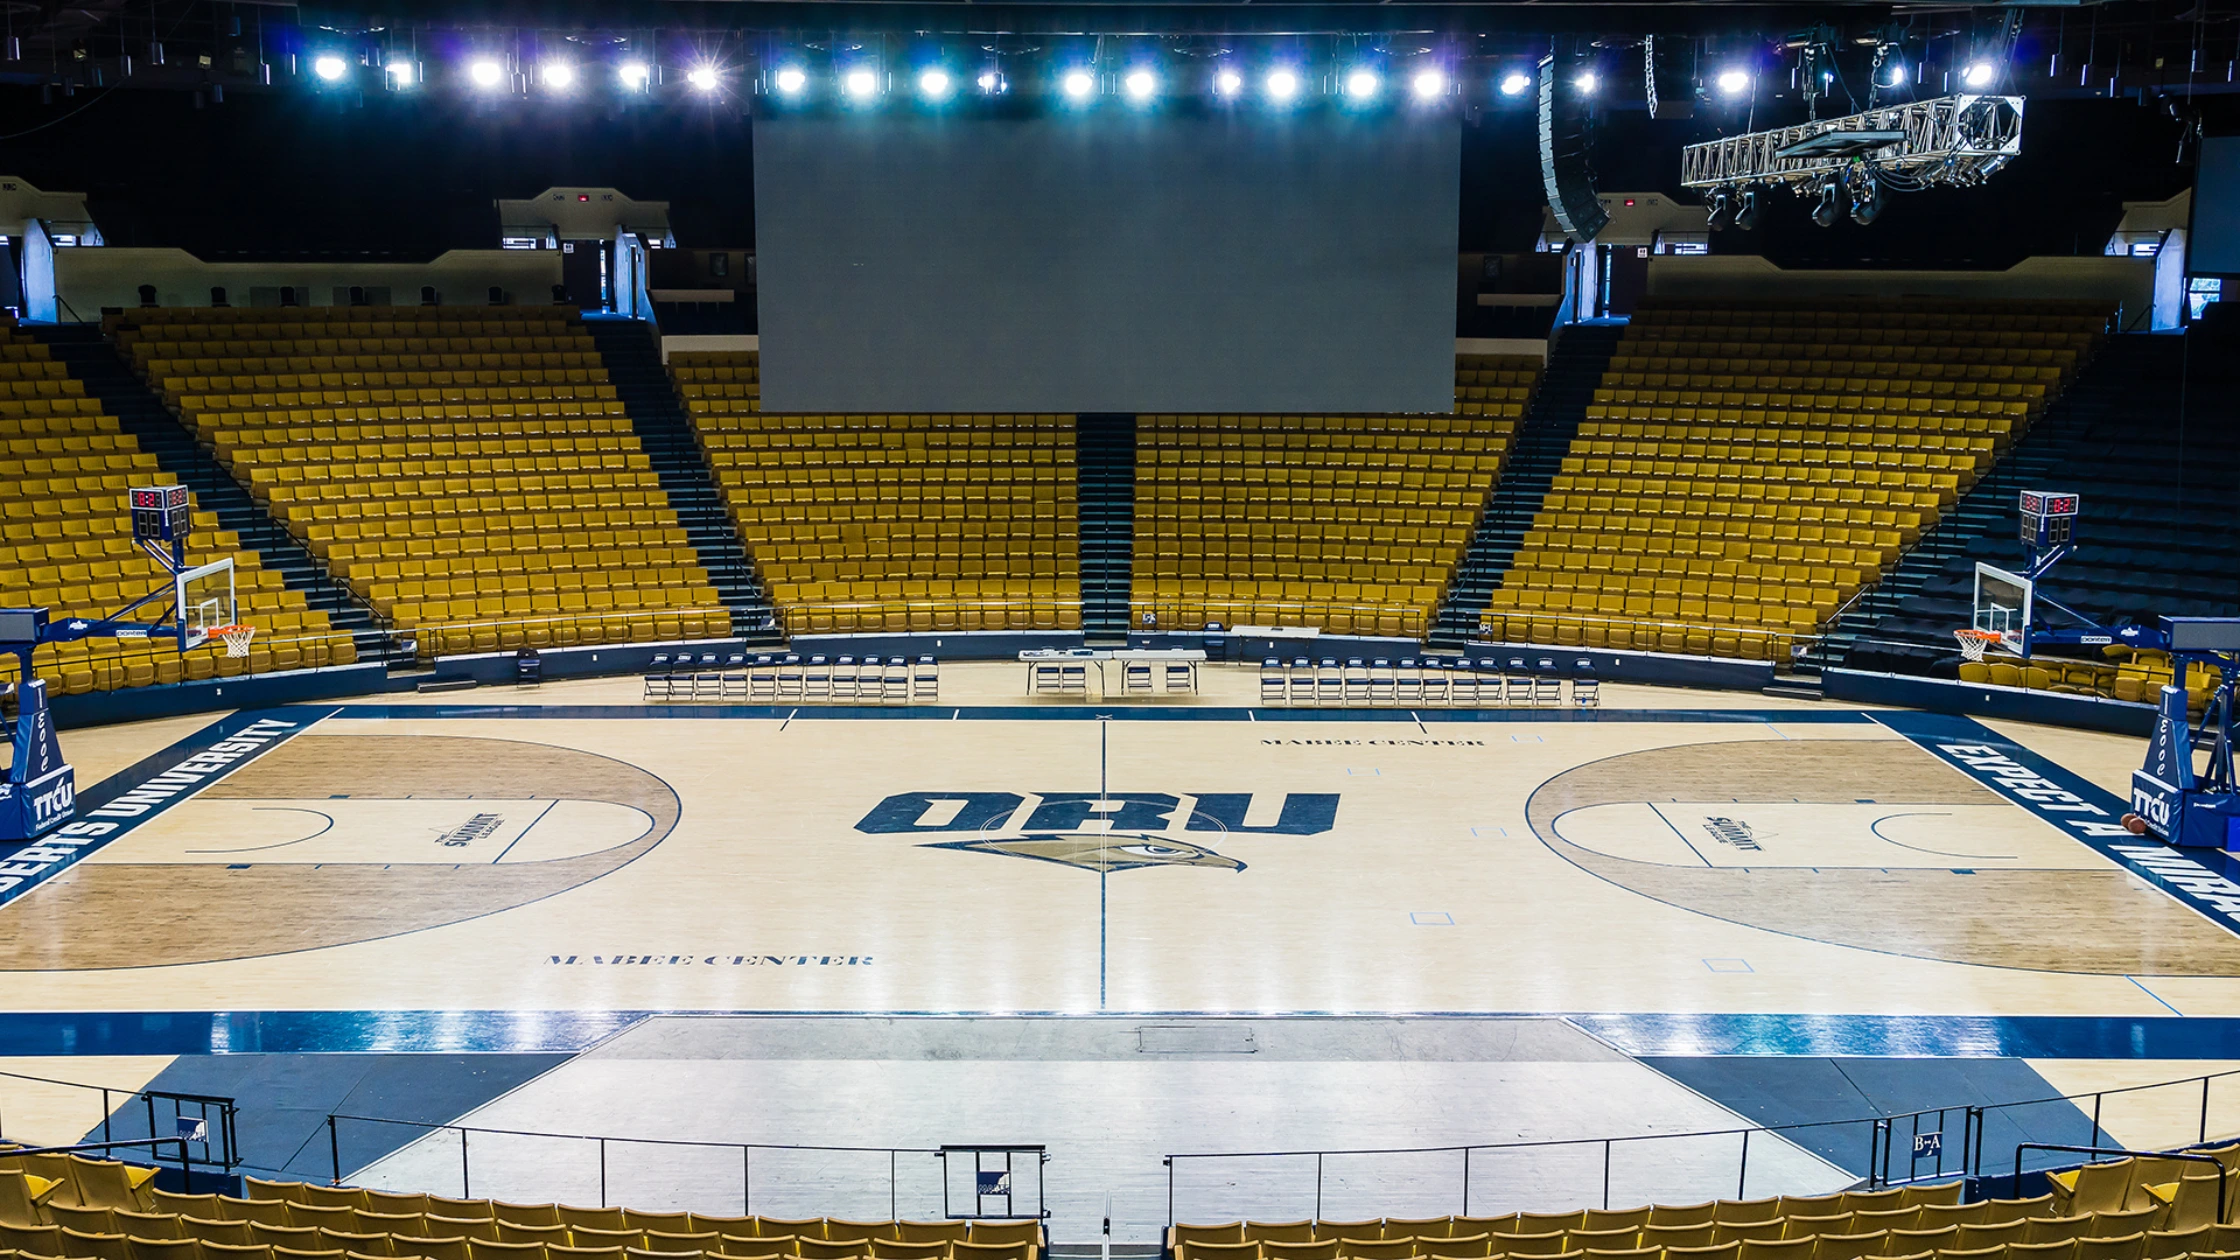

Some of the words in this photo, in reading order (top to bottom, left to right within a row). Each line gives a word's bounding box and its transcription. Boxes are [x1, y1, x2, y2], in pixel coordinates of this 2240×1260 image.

[85, 718, 298, 817] UNIVERSITY
[1936, 744, 2110, 816] EXPECT
[33, 777, 73, 821] TTCU
[853, 791, 1341, 836] ORU
[2133, 787, 2170, 826] TTCU
[543, 955, 694, 966] MABEE
[704, 955, 874, 966] CENTER
[1914, 1135, 1941, 1151] B-A
